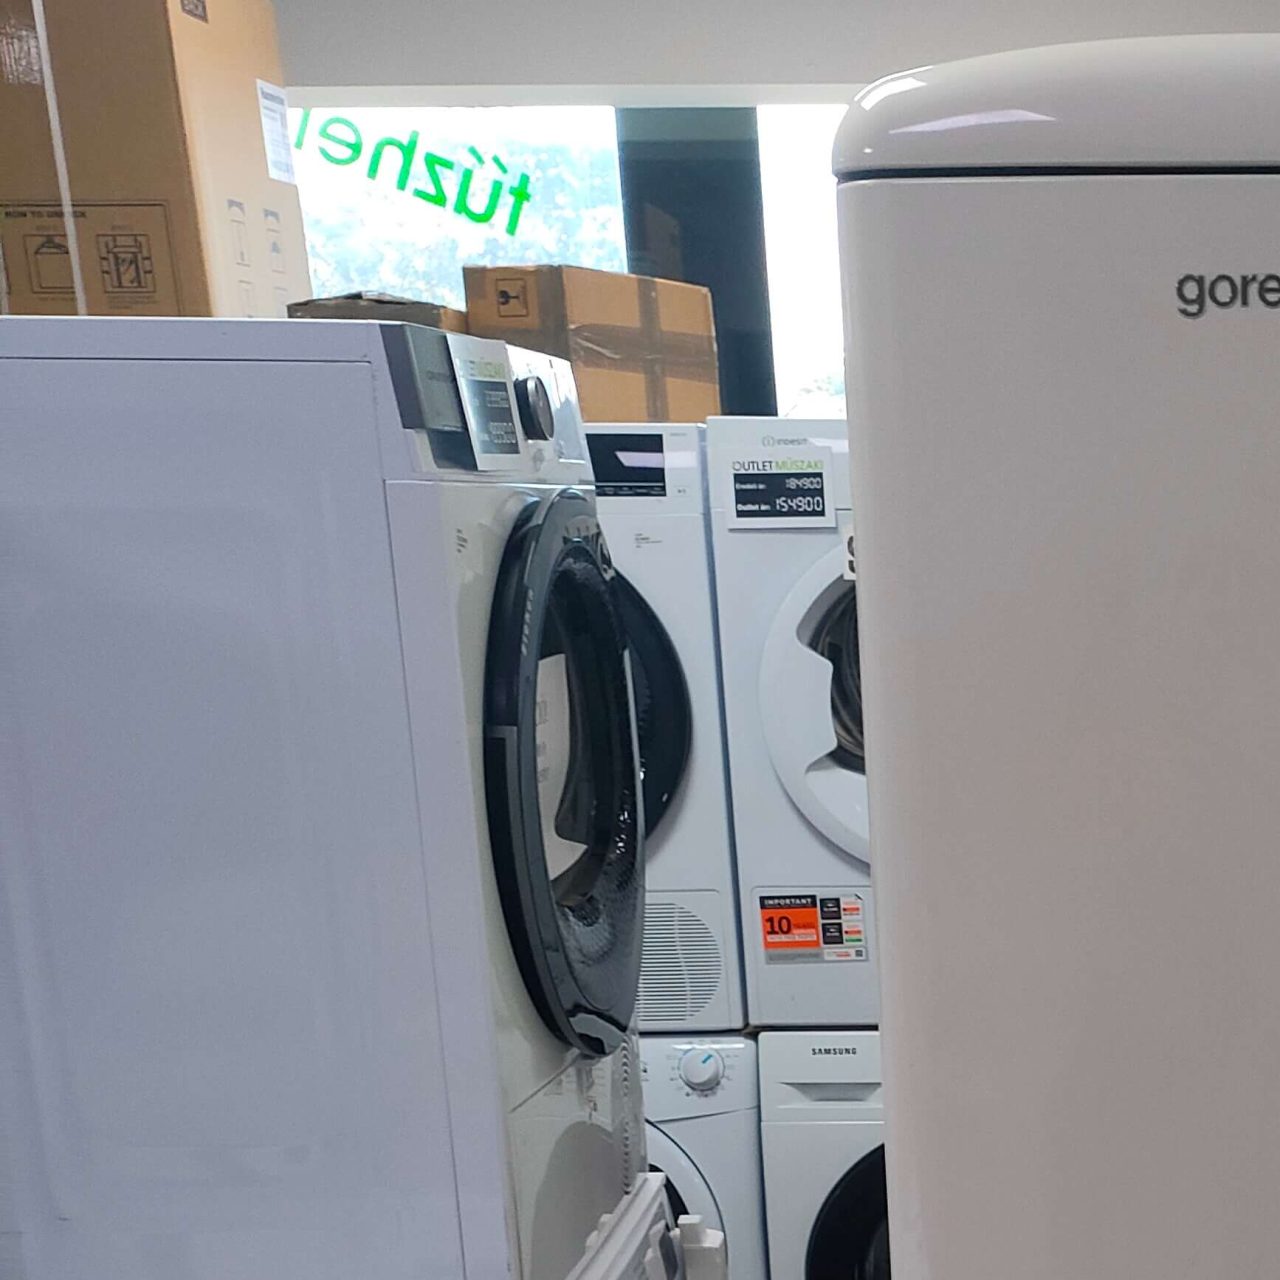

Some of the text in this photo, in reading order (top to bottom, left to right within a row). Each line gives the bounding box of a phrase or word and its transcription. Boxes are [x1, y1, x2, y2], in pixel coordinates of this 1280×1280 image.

[732, 460, 773, 471] OUTLET
[776, 496, 823, 512] 154900
[764, 898, 812, 906] IMPORTANT
[765, 915, 792, 936] 10
[811, 1047, 857, 1056] SAMSUNG
